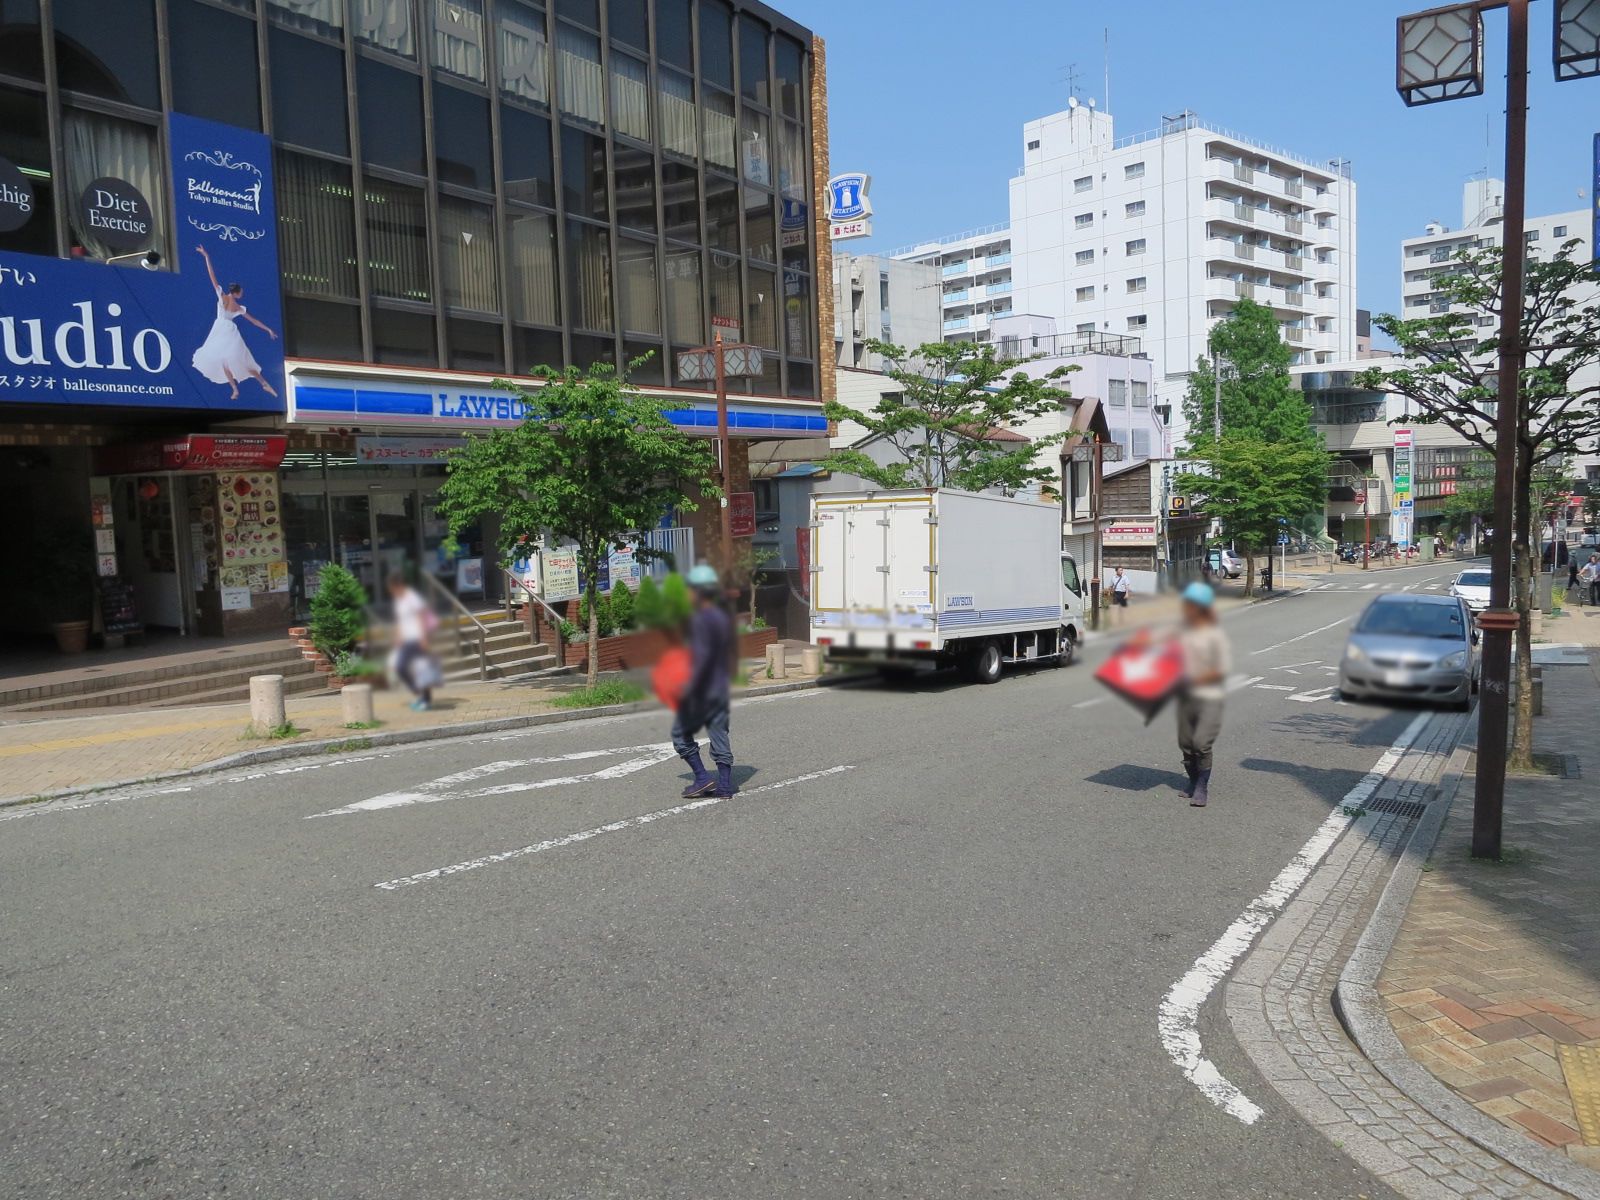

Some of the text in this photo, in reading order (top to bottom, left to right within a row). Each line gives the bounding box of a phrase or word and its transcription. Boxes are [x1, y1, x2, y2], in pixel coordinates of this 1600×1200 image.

[187, 178, 254, 202] Ballesonance
[833, 180, 861, 190] LAWSON
[0, 184, 31, 212] hig
[95, 189, 139, 214] Diet
[188, 191, 254, 211] Tokyo Ballet Studio
[832, 205, 861, 215] STATION
[88, 208, 147, 234] Exercise
[63, 378, 174, 395] ballesonance.com
[947, 595, 974, 607] LAWSON
